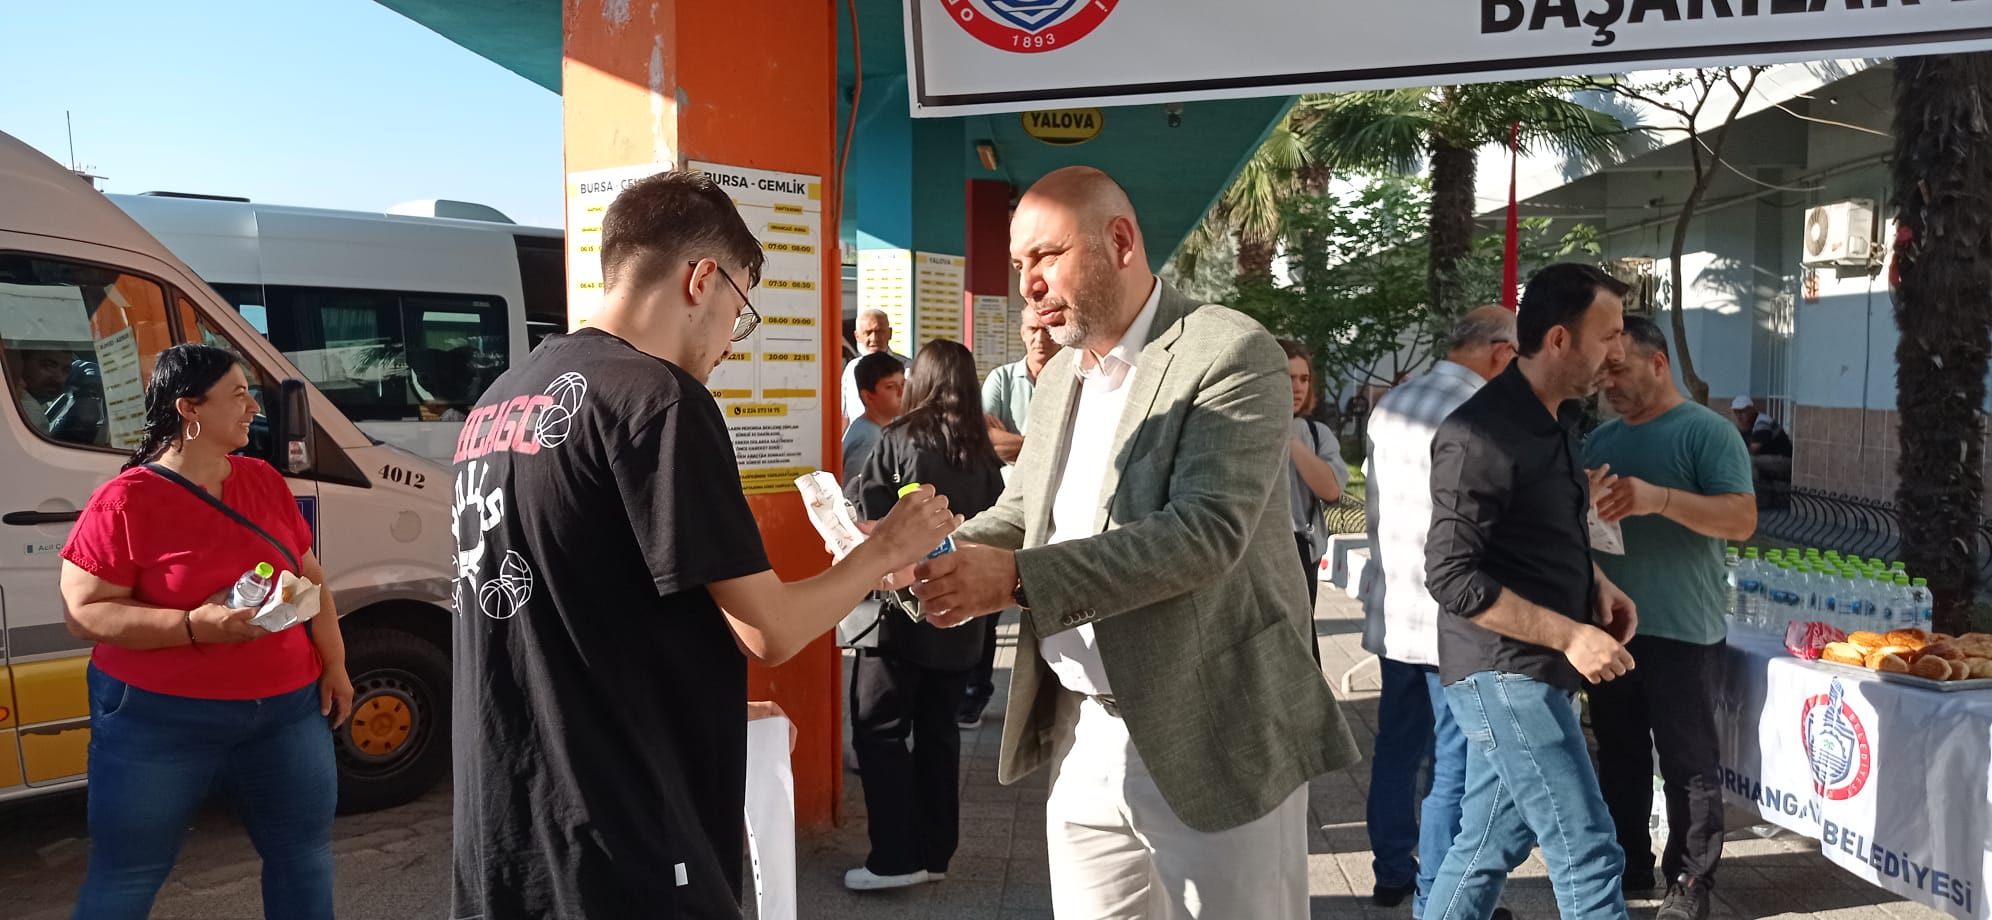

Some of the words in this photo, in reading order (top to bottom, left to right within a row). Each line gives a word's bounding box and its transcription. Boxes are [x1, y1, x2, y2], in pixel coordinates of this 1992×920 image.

[1012, 33, 1055, 48] 1893
[1031, 112, 1094, 129] YALOVA
[580, 181, 613, 194] BURSA
[704, 172, 748, 188] BURSA
[758, 179, 805, 195] GEMLİK
[929, 257, 951, 265] YALOVA
[378, 464, 425, 489] 4012
[1822, 819, 1972, 914] BELEDİYESİ
